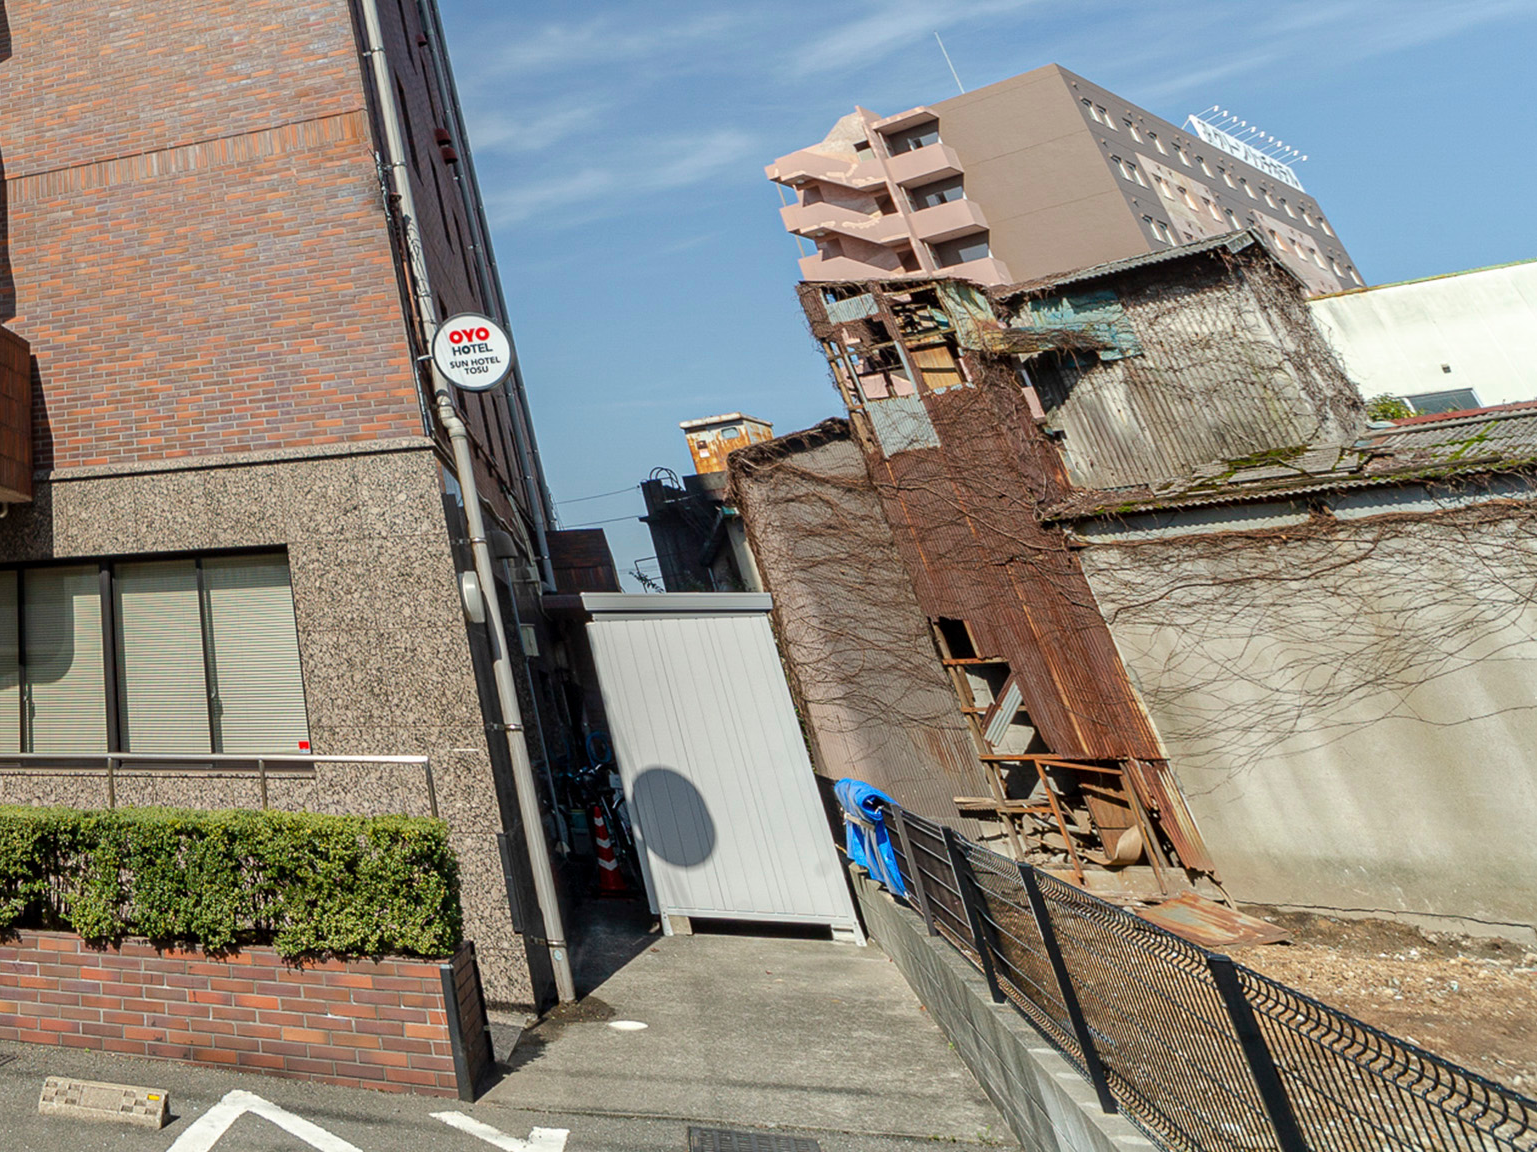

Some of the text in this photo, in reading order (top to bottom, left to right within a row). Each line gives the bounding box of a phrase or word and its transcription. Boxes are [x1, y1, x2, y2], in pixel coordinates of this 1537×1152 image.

[449, 326, 490, 344] OYO
[452, 342, 493, 356] HOTEL
[449, 356, 501, 369] SUN HOTEL
[464, 366, 489, 375] TOSU
